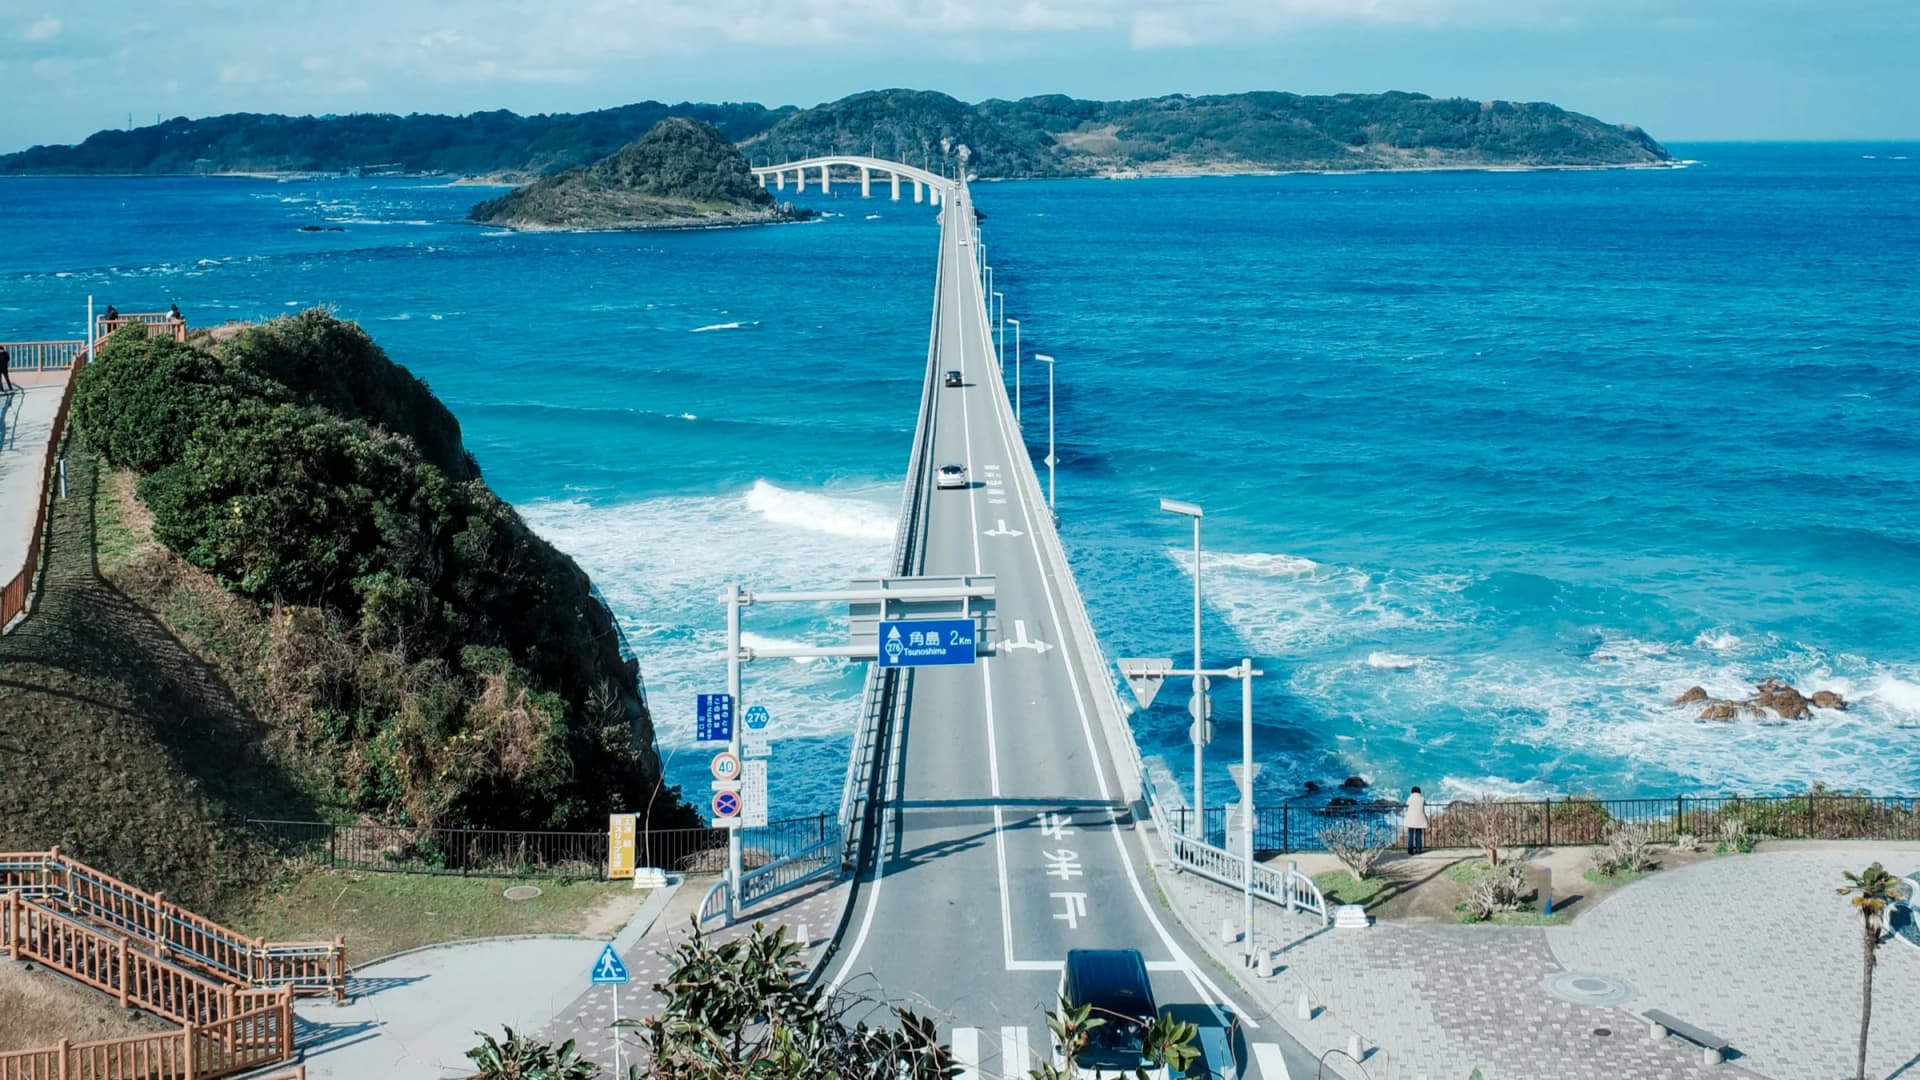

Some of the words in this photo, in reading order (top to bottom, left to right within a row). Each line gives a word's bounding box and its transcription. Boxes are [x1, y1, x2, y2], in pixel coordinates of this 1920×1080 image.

[909, 630, 940, 646] 角島
[904, 647, 946, 656] Tsunoshima
[747, 712, 767, 723] 276
[719, 761, 734, 773] 40
[1037, 812, 1087, 929] 止まれ
